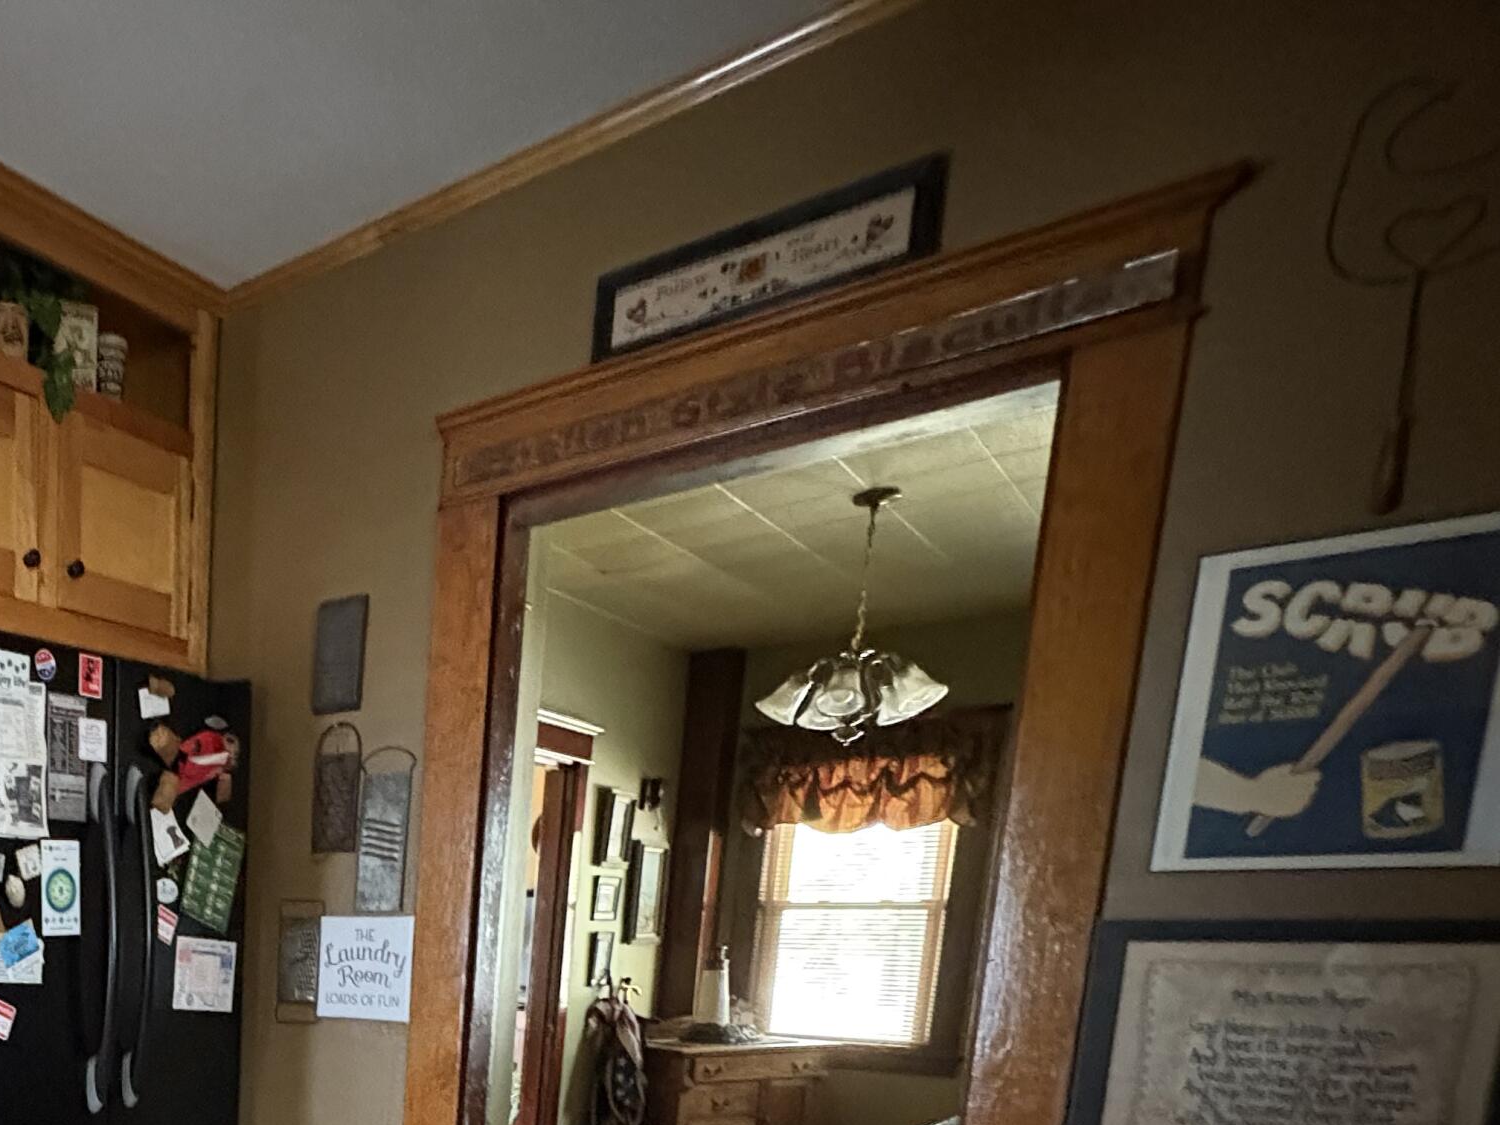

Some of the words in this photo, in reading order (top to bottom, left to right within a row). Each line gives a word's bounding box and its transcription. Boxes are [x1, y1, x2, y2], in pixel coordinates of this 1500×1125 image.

[355, 928, 375, 942] THE
[324, 939, 406, 978] Laundry
[337, 965, 391, 989] Room
[325, 992, 358, 1006] LOADS
[361, 994, 376, 1007] OF
[377, 994, 400, 1008] FUN
